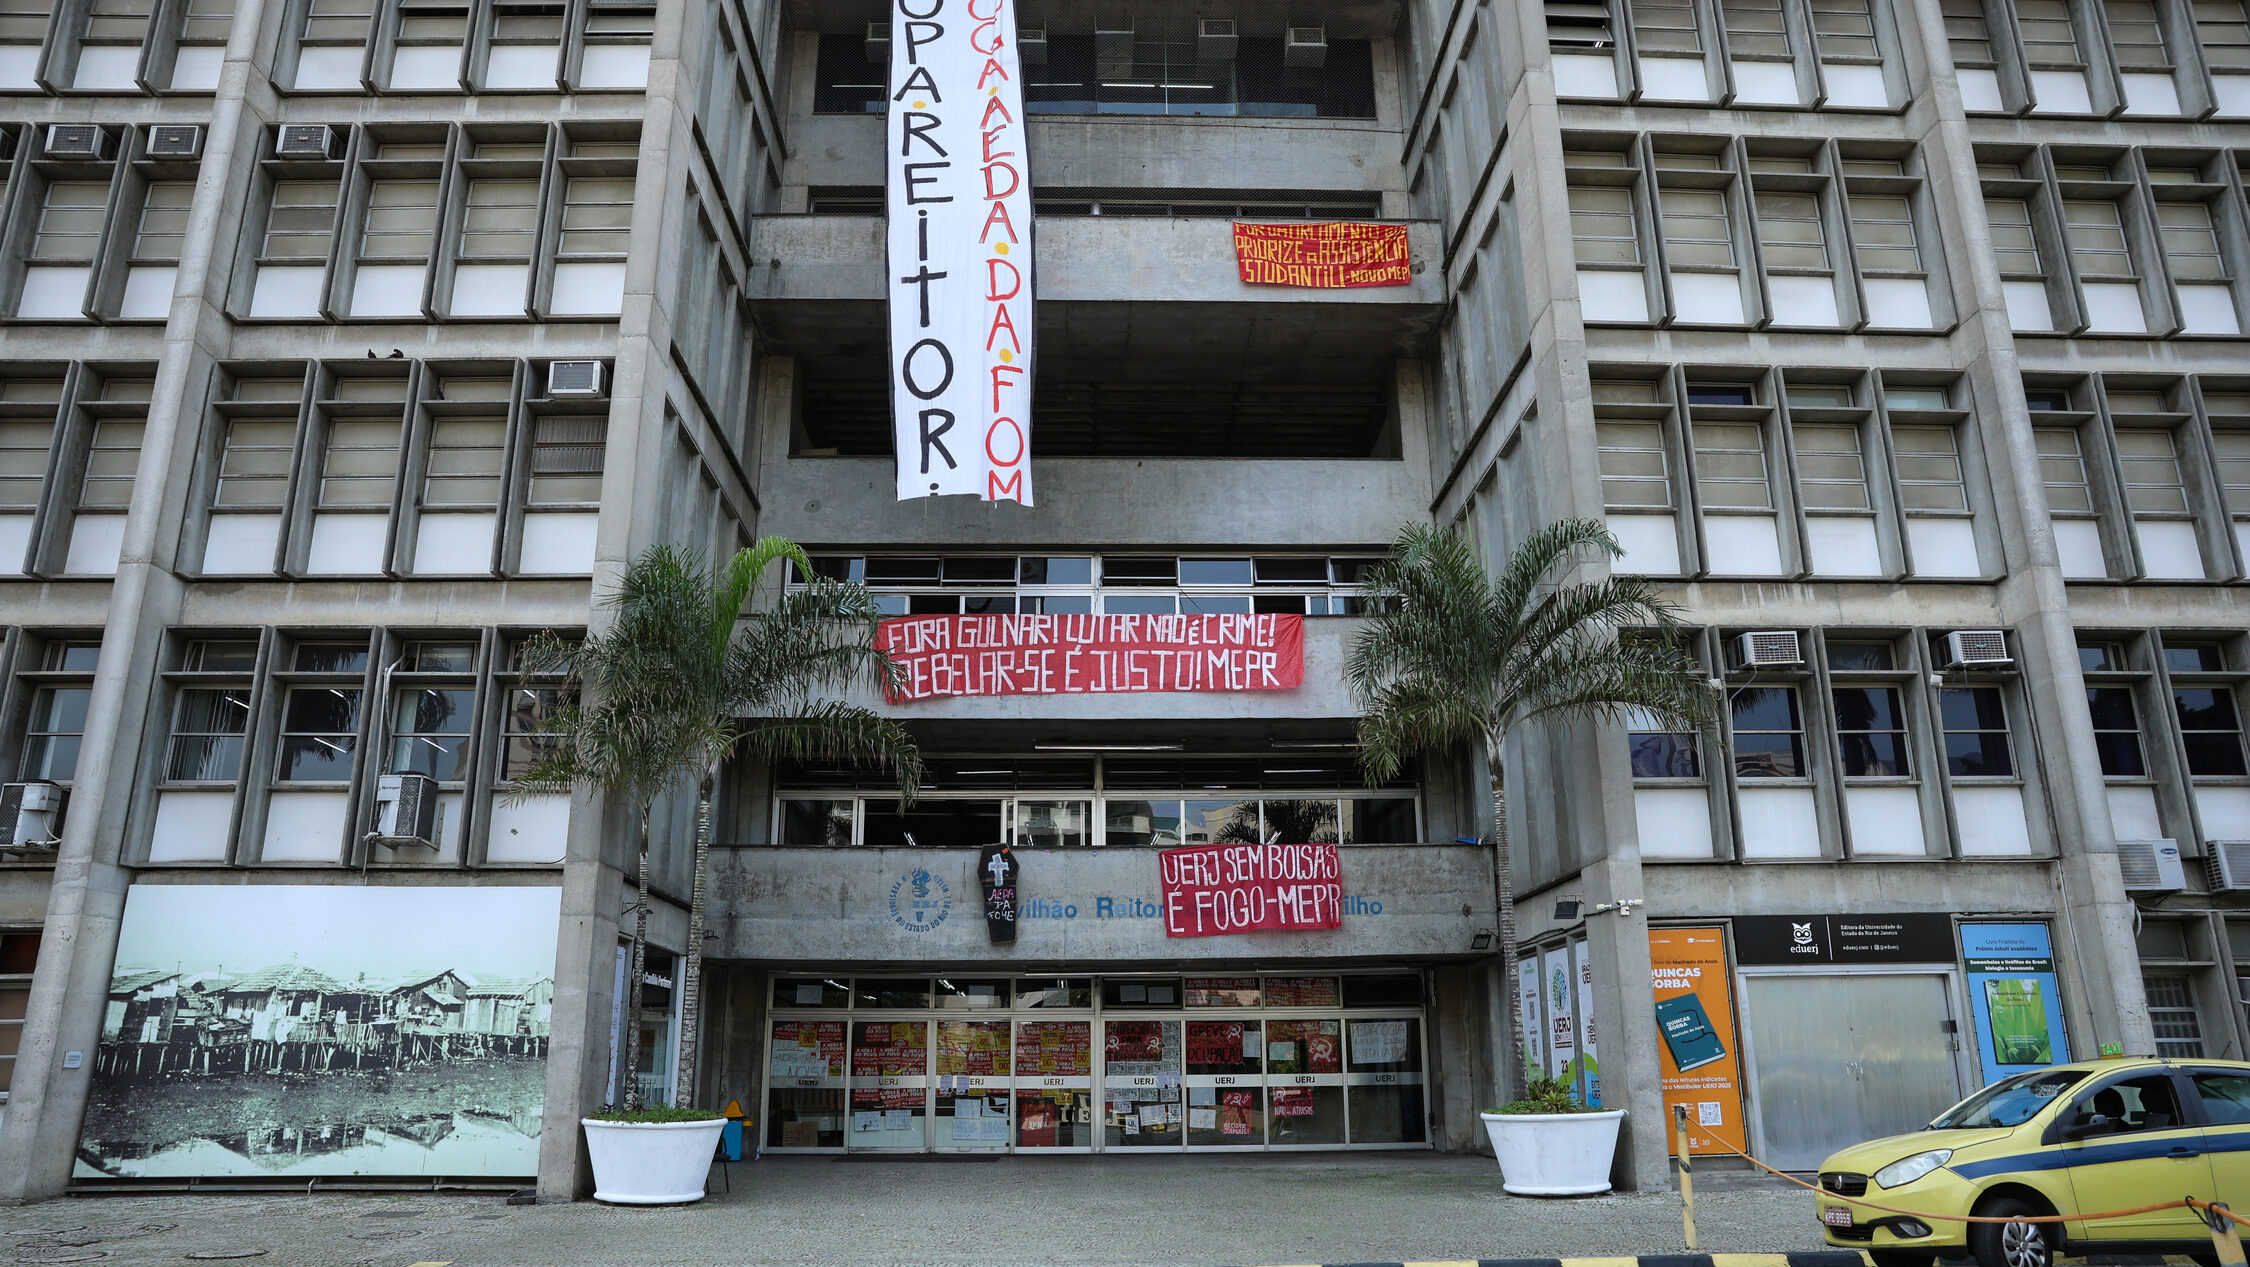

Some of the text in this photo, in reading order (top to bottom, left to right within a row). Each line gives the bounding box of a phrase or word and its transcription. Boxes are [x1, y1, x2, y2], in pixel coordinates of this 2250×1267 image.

[1235, 235, 1304, 264] PRIORIZE
[888, 618, 950, 653] FORA
[957, 614, 1058, 648] GULNAR!
[1066, 614, 1140, 644] LUTAR
[1203, 614, 1276, 648] CRIME!
[1065, 645, 1083, 692] É
[1090, 650, 1202, 692] JUSTO!
[1208, 649, 1280, 689] MEPR
[1162, 844, 1338, 886] UERJ SEM BOLSAS
[1168, 884, 1185, 933] É
[1790, 944, 1818, 955] eduerj
[1554, 1016, 1571, 1034] UERJ
[2100, 1042, 2121, 1056] TAXI
